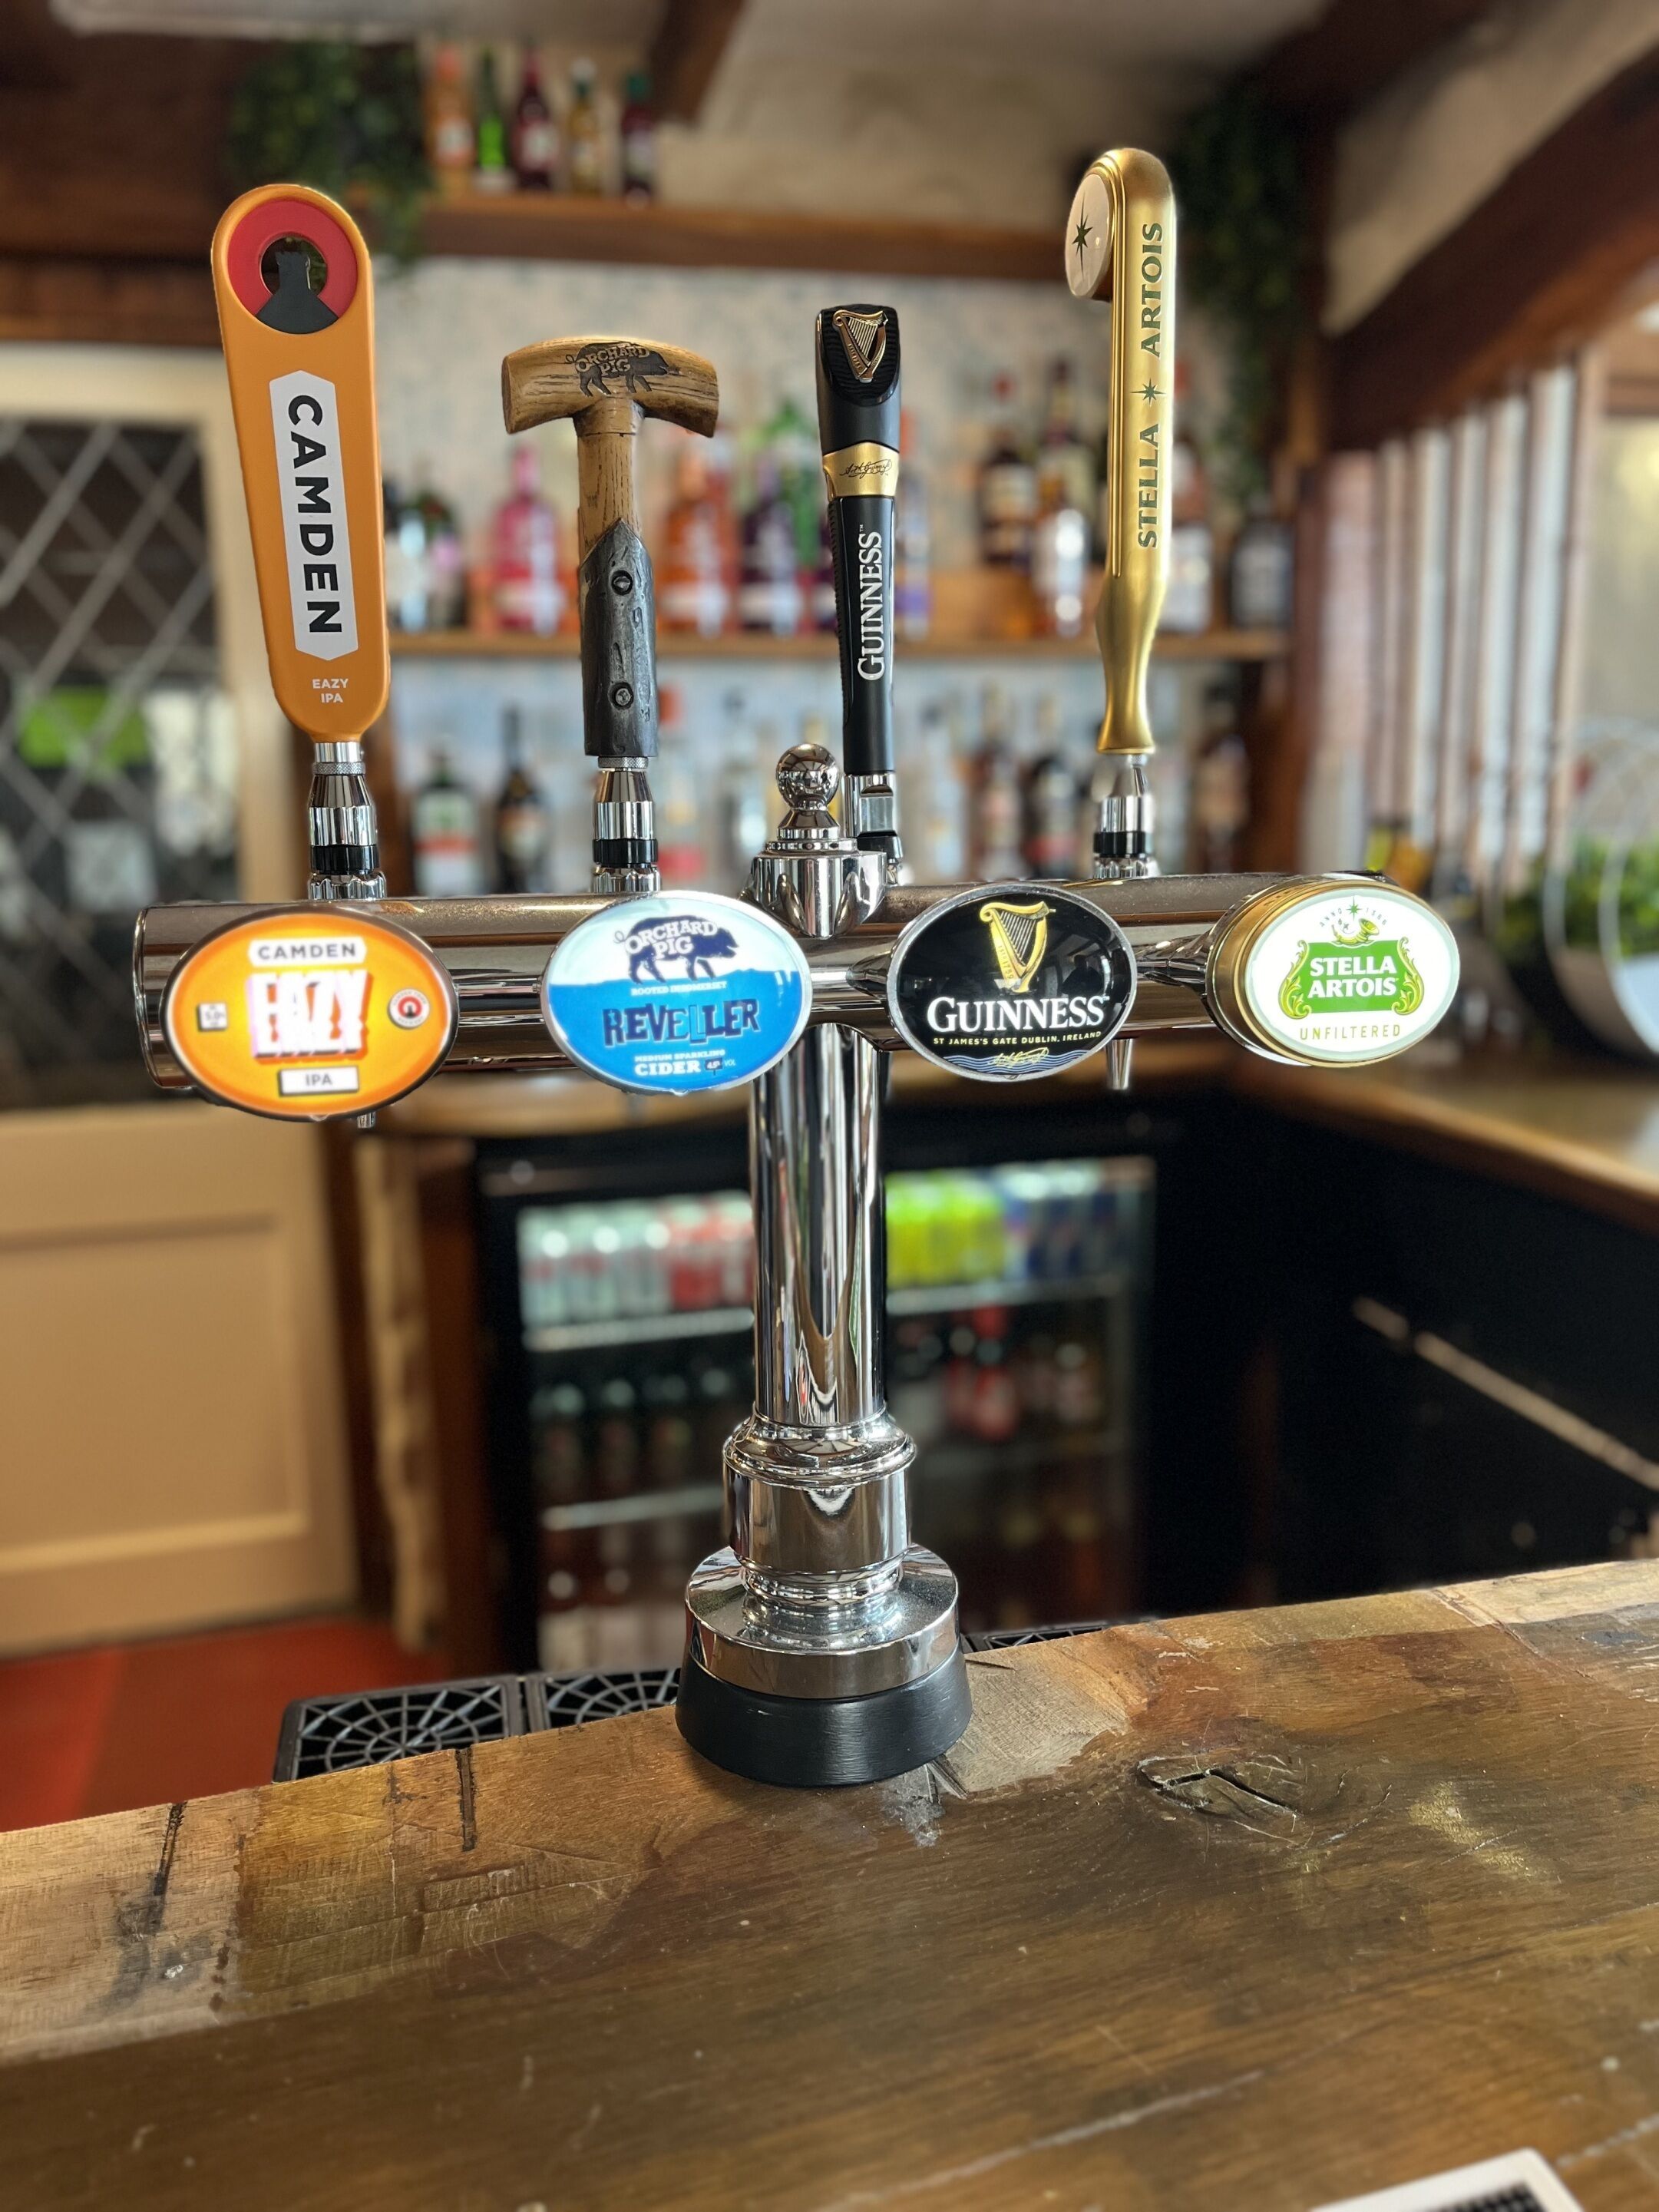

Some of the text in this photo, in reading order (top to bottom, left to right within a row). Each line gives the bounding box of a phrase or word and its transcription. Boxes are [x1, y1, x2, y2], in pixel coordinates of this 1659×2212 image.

[576, 342, 649, 372] ORCHARD
[600, 359, 630, 376] PIG
[1138, 223, 1162, 548] STELLA ARTOIS
[288, 395, 342, 633] CAMDEN
[858, 531, 885, 681] GUINNESS
[312, 678, 349, 689] EAZY
[321, 693, 343, 703] IPA
[625, 920, 718, 954] ORCHARD
[258, 944, 355, 960] CAMDEN
[653, 936, 694, 959] PIG
[1310, 955, 1397, 977] STELLA
[631, 984, 669, 996] ROOTED
[1307, 977, 1396, 999] ARTOIS
[603, 998, 761, 1047] REVELLER
[927, 996, 1105, 1033] GUINNESS
[1062, 1030, 1102, 1042] IRELAND
[1300, 1024, 1400, 1040] UNFILTERED
[634, 1049, 725, 1063] MEDIUM SPARKLING
[634, 1060, 702, 1076] CIDER
[306, 1073, 332, 1086] IPA
